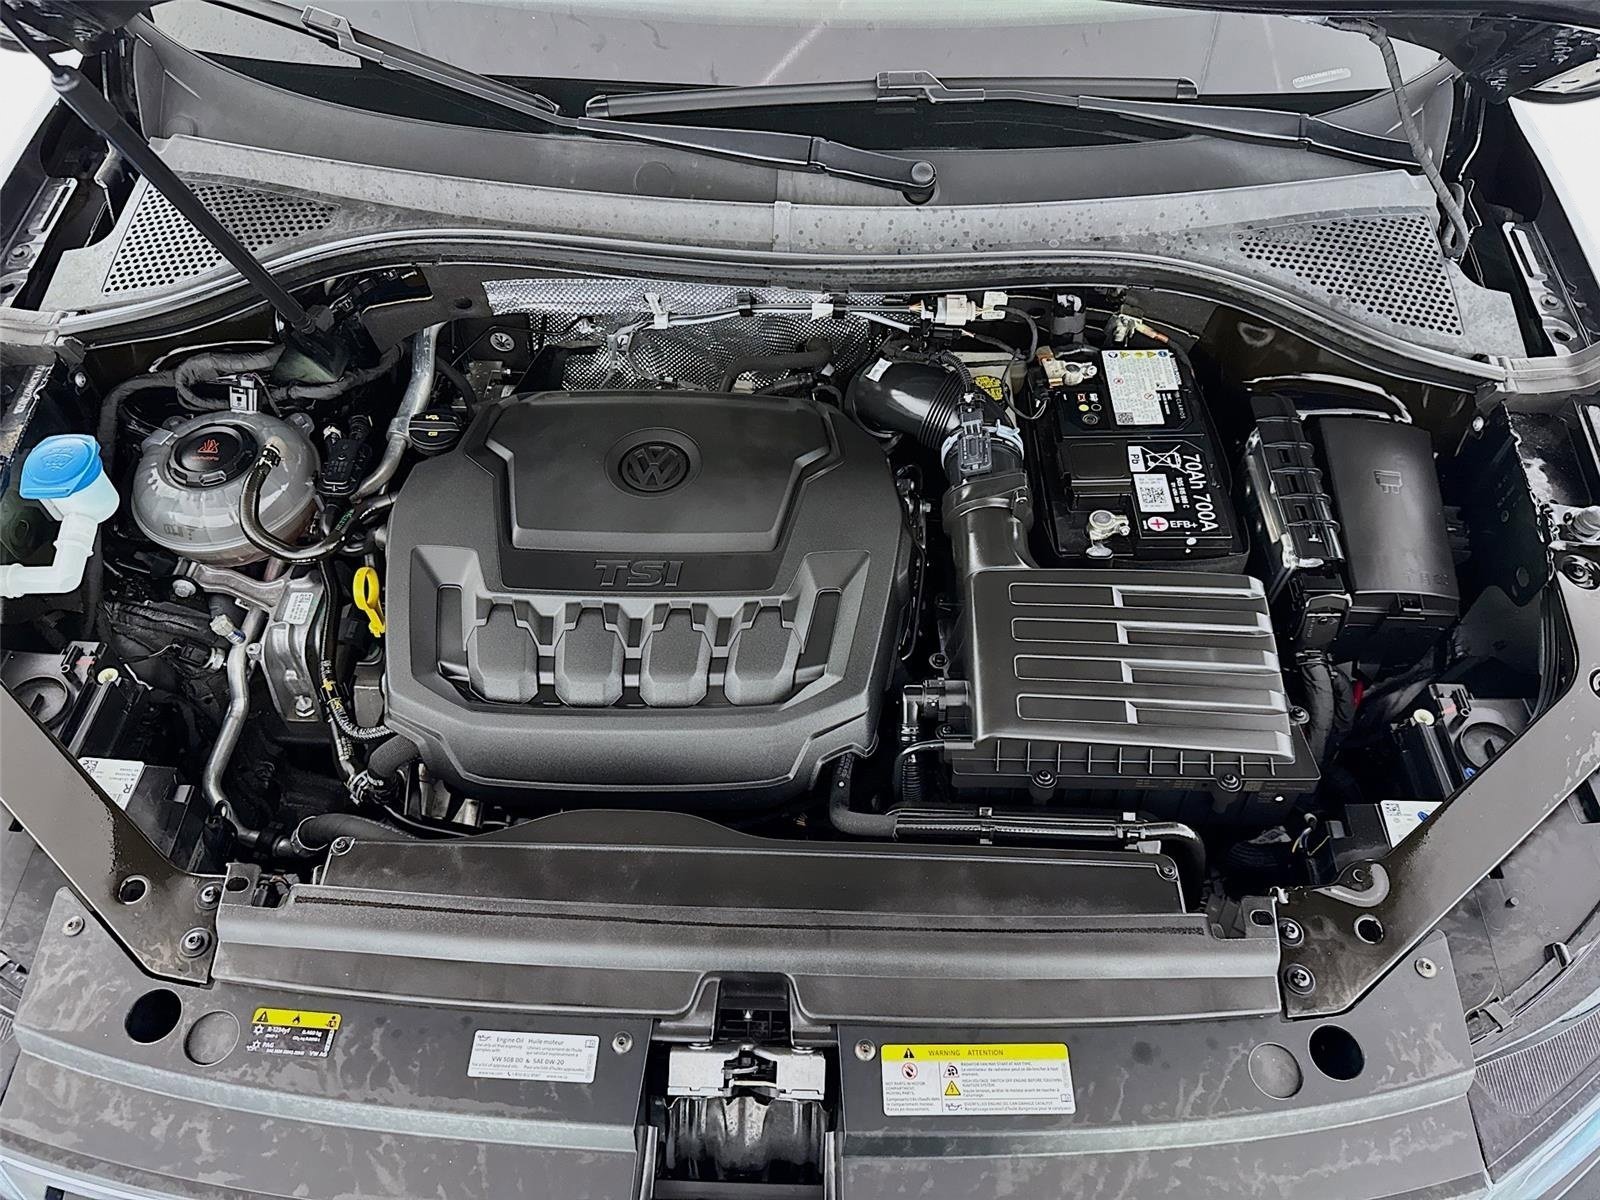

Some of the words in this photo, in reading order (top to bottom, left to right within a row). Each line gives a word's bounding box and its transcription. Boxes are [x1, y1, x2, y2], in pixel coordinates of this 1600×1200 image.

[1130, 453, 1140, 465] Pb
[1183, 453, 1207, 489] 70Ah
[1193, 493, 1219, 532] 700A
[1169, 520, 1198, 529] EFB+
[594, 560, 684, 587] TSI
[123, 784, 133, 794] R
[496, 1037, 515, 1045] Engine
